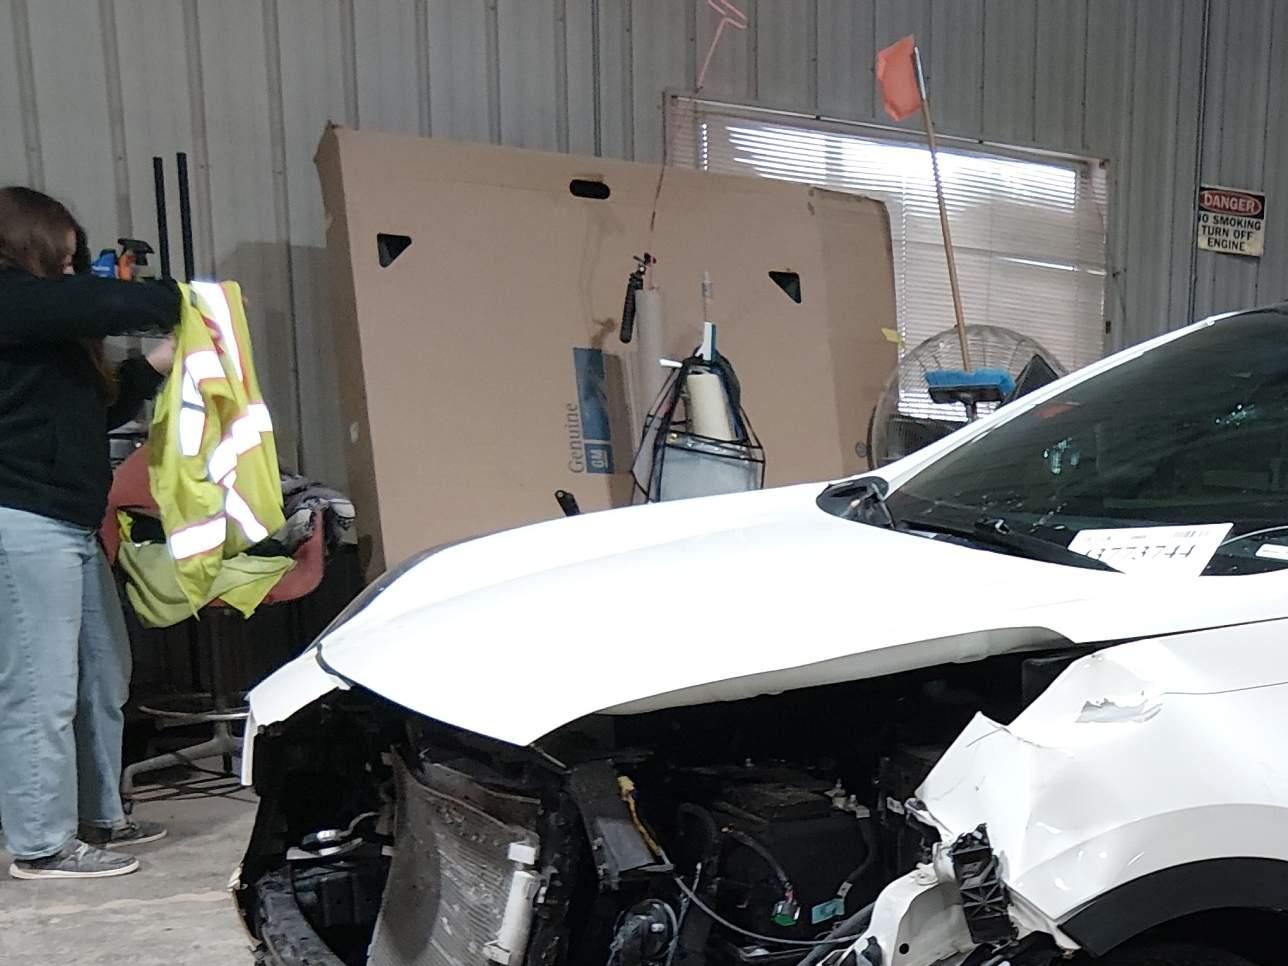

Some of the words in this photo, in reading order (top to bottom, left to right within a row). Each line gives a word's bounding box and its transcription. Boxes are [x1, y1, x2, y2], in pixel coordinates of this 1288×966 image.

[1204, 191, 1255, 213] DANGER
[1213, 215, 1262, 231] SMOKING
[1202, 225, 1230, 238] TURN
[1233, 229, 1254, 241] OFF
[1207, 237, 1246, 252] ENGINE
[566, 403, 585, 473] Genuine
[590, 449, 608, 468] GM
